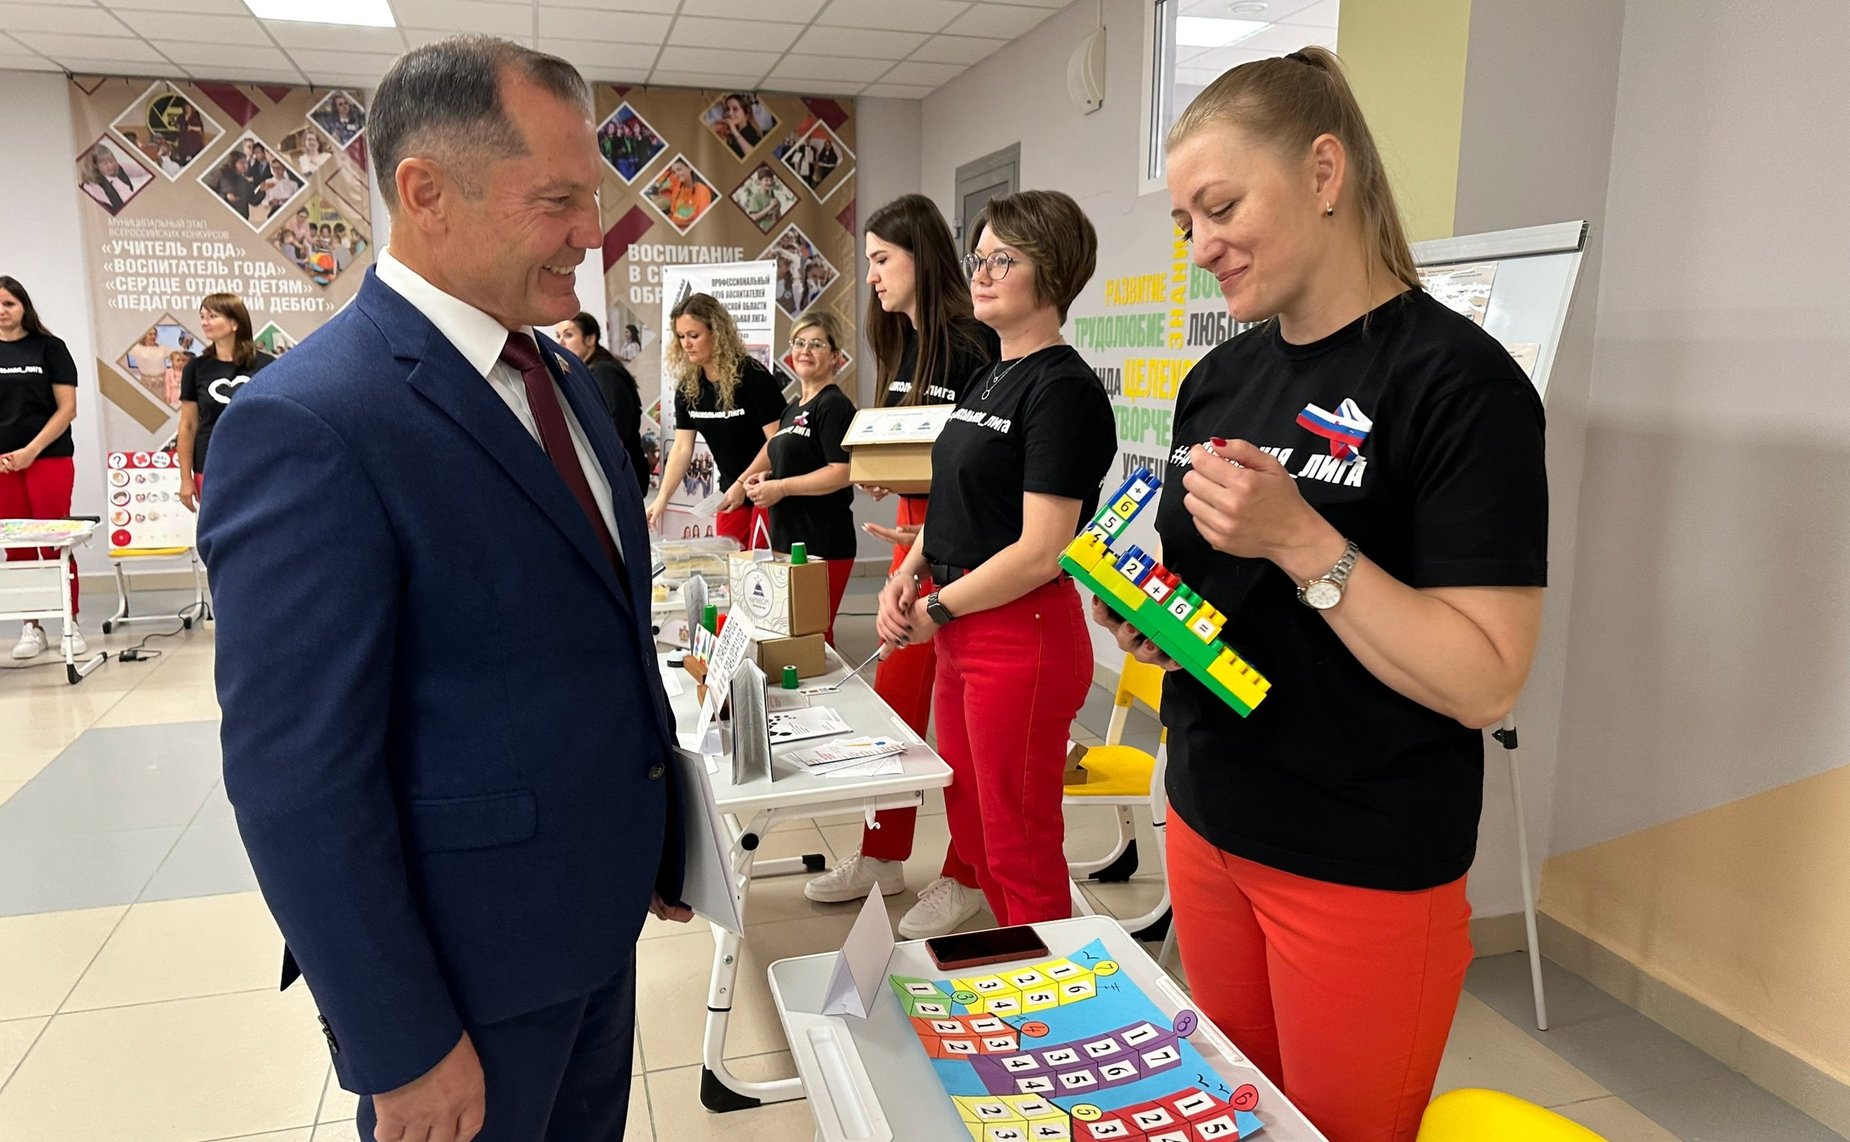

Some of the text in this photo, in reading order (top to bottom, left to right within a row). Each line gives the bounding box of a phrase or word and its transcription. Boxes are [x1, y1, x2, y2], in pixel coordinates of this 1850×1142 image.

[108, 217, 208, 230] МУНИЦИПАЛЬНЫЙ ЭТАП
[109, 226, 230, 240] ВСЕРОССИЙСКИХ КОНКУРСОВ
[102, 239, 246, 259] «УЧИТЕЛЬ ГОДА»
[627, 243, 745, 263] ВОСПИТАНИЕ
[103, 258, 287, 278] «ВОСПИТАТЕЛЬ ГОДА»
[628, 264, 662, 283] В С
[105, 276, 313, 297] «СЕРДЦЕ ОТДАЮ ДЕТЯМ»
[1105, 272, 1168, 307] РАЗВИТИЕ
[269, 297, 335, 314] ДЕБЮТ»
[1074, 312, 1166, 353] ТРУДОЛЮБИЕ
[1120, 500, 1133, 512] 6
[1104, 516, 1117, 528] 5
[1127, 562, 1138, 575] 2
[1174, 603, 1187, 615] 6
[1017, 975, 1050, 1002] 2 5
[1054, 967, 1085, 993] 1 6
[994, 1001, 1012, 1009] 4
[1176, 1016, 1192, 1033] 8
[948, 1043, 969, 1051] 2
[989, 1040, 1010, 1048] 3
[1130, 1030, 1171, 1061] 1 7
[1049, 1053, 1088, 1085] 3 5
[1090, 1043, 1128, 1076] 2 6
[1011, 1060, 1045, 1089] 4 4
[1234, 1091, 1253, 1106] 6
[1076, 1108, 1098, 1116] 5
[1140, 1113, 1163, 1124] 2
[1183, 1099, 1228, 1134] 1 5
[980, 1107, 1018, 1139] 2 3
[1039, 1127, 1061, 1136] 4
[1095, 1125, 1118, 1134] 3
